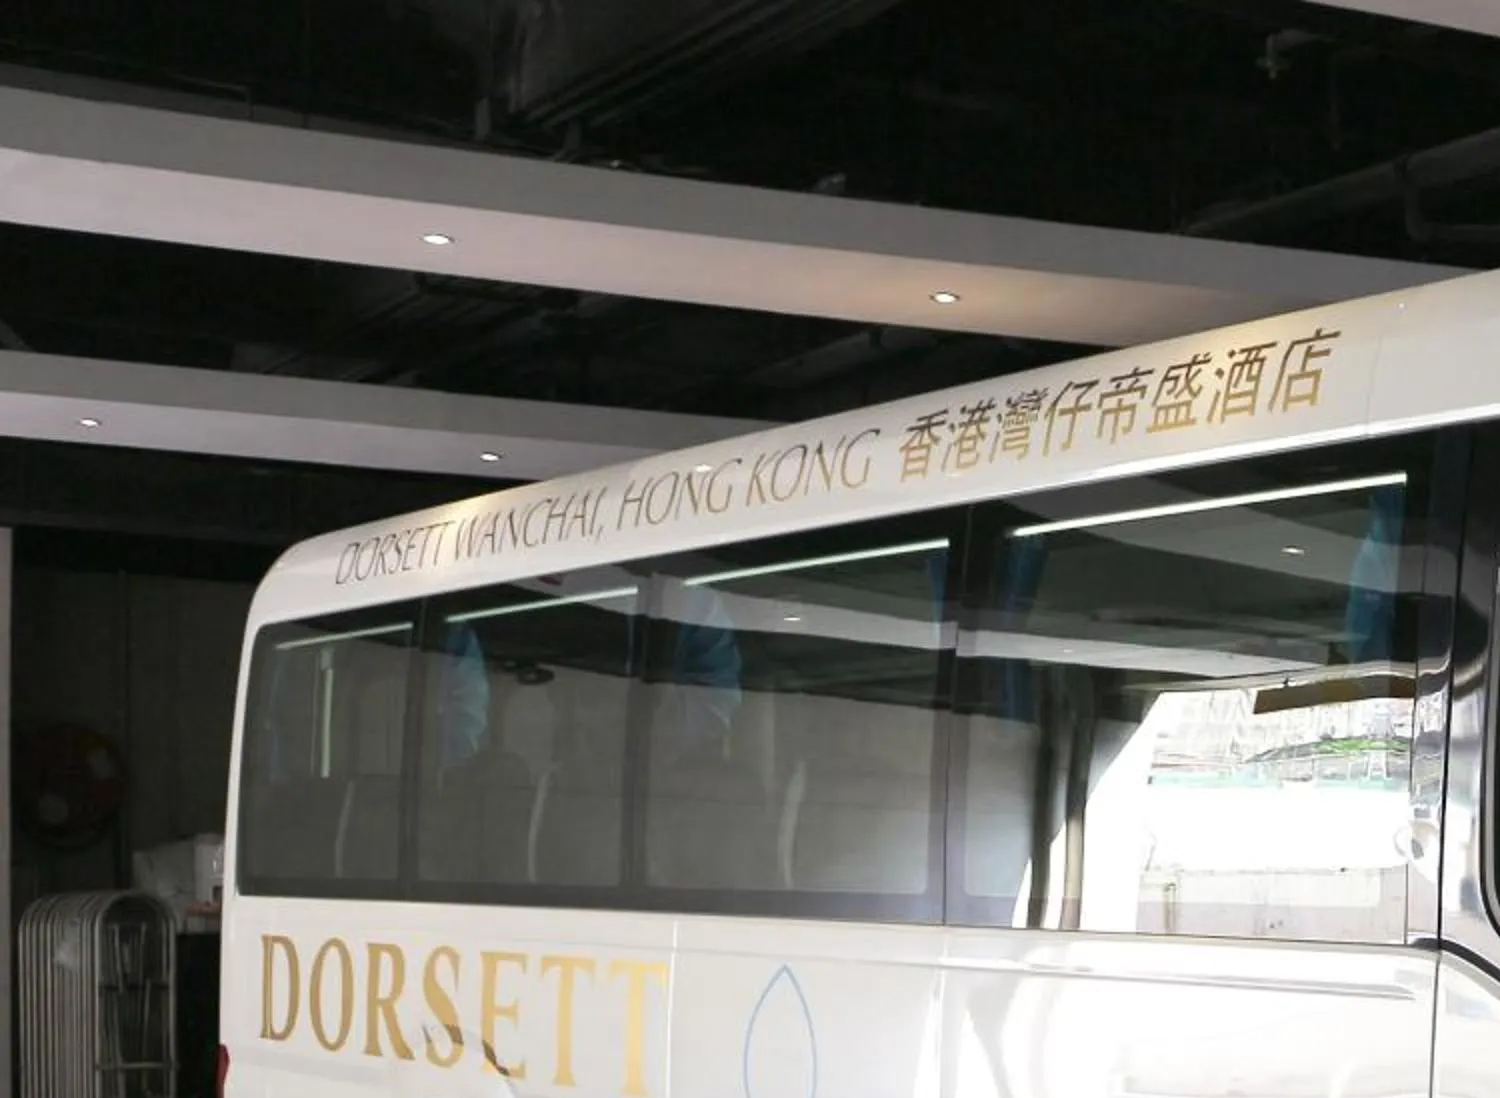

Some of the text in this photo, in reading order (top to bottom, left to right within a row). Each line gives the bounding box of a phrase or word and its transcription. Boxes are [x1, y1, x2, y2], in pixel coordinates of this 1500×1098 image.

[898, 327, 1342, 481] 香港灣仔帝盛酒店
[335, 428, 881, 585] DORSETT WANCHAI, HONG KONG
[260, 933, 669, 1097] DORSETT
